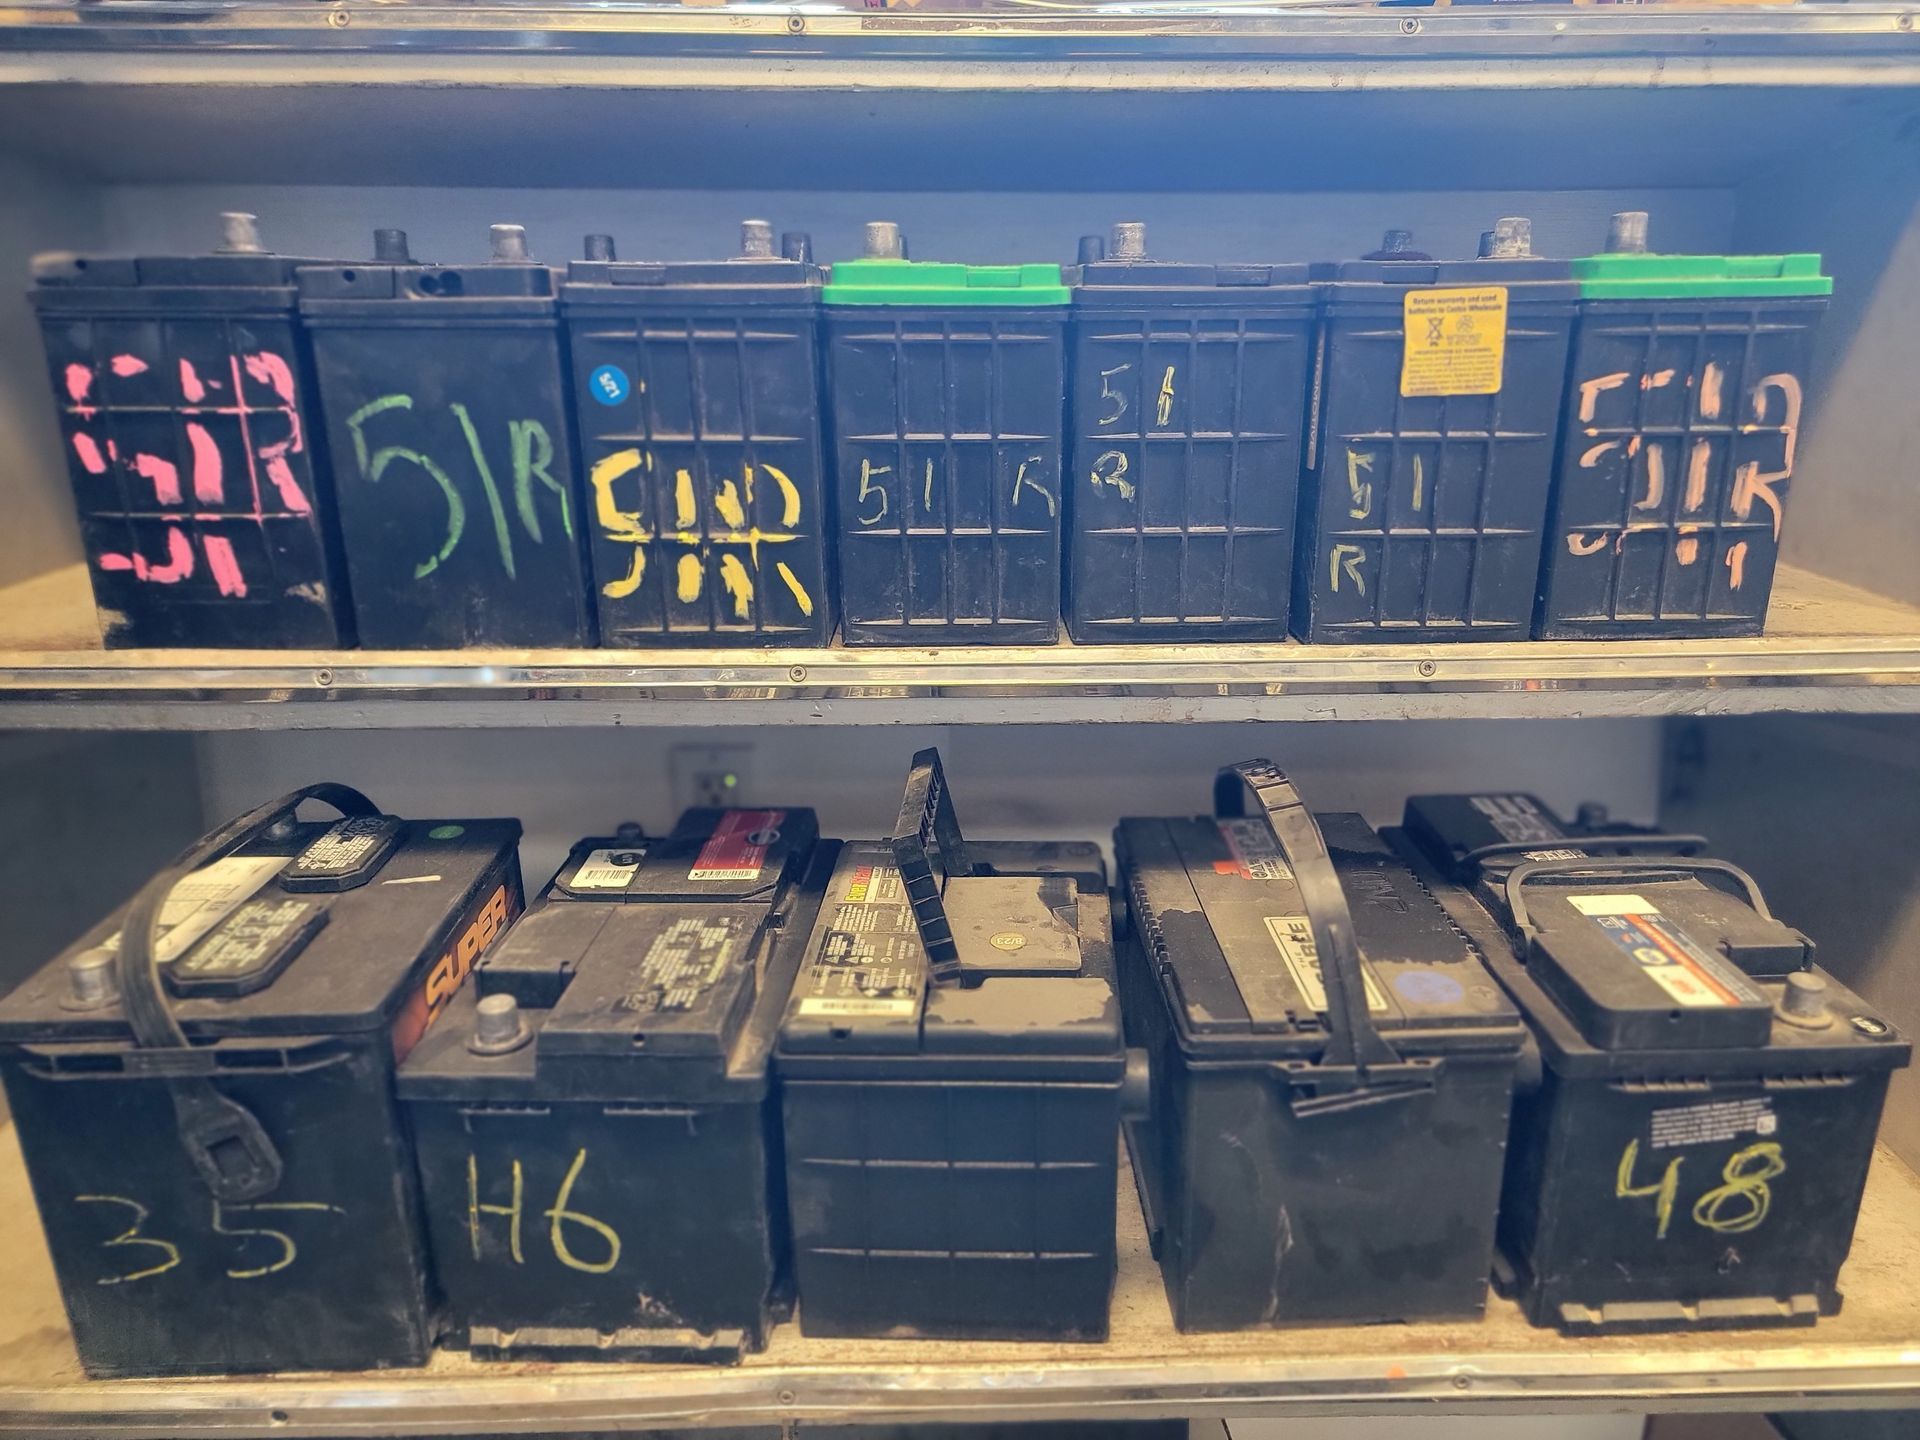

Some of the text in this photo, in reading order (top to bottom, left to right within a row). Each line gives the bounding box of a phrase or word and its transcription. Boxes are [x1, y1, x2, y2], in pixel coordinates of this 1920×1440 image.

[598, 371, 622, 399] 5/21
[347, 394, 574, 580] 51R
[1089, 450, 1136, 502] R
[1329, 543, 1367, 598] R
[426, 884, 507, 1027] SUPER
[996, 937, 1024, 945] 8/23
[1294, 951, 1308, 969] THE
[467, 1147, 622, 1274] H6
[1616, 1136, 1786, 1240] 48
